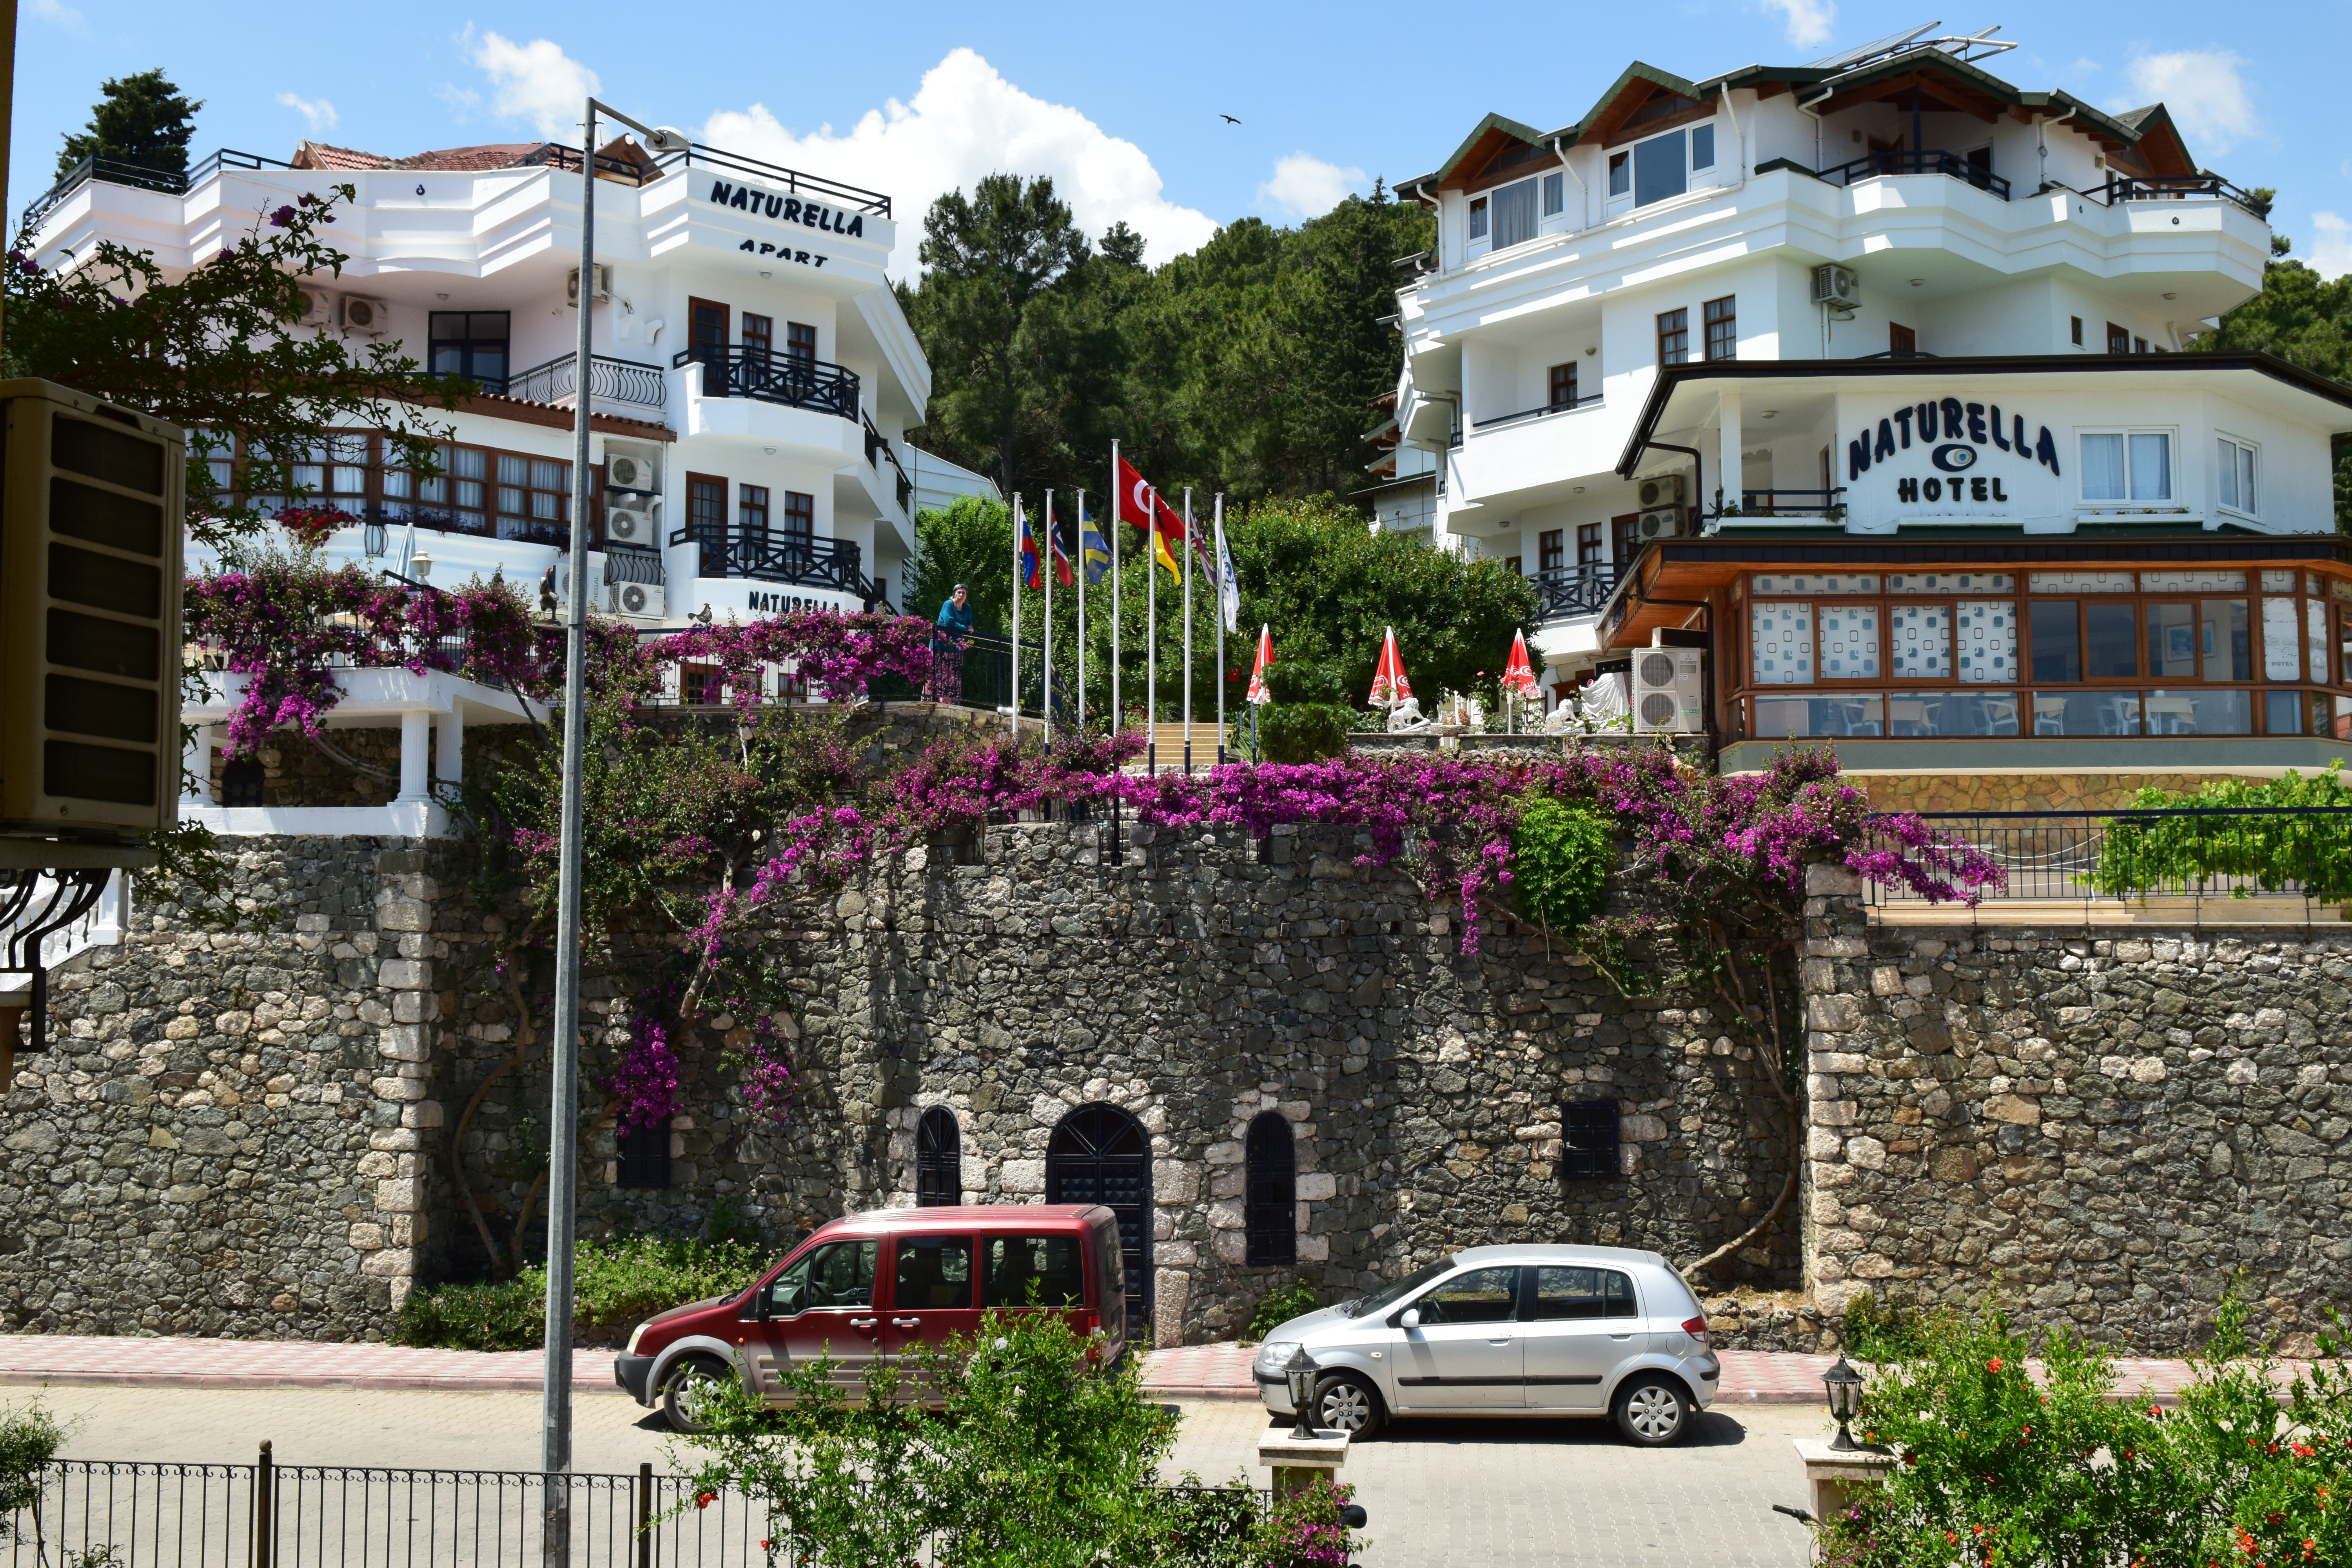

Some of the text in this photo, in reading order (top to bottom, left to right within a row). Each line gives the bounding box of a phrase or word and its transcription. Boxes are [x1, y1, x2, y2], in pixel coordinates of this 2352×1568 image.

[711, 181, 862, 238] NATURELLA
[739, 239, 828, 267] APART
[1849, 397, 2060, 481] NATURELLA
[1898, 477, 2007, 502] HOTEL
